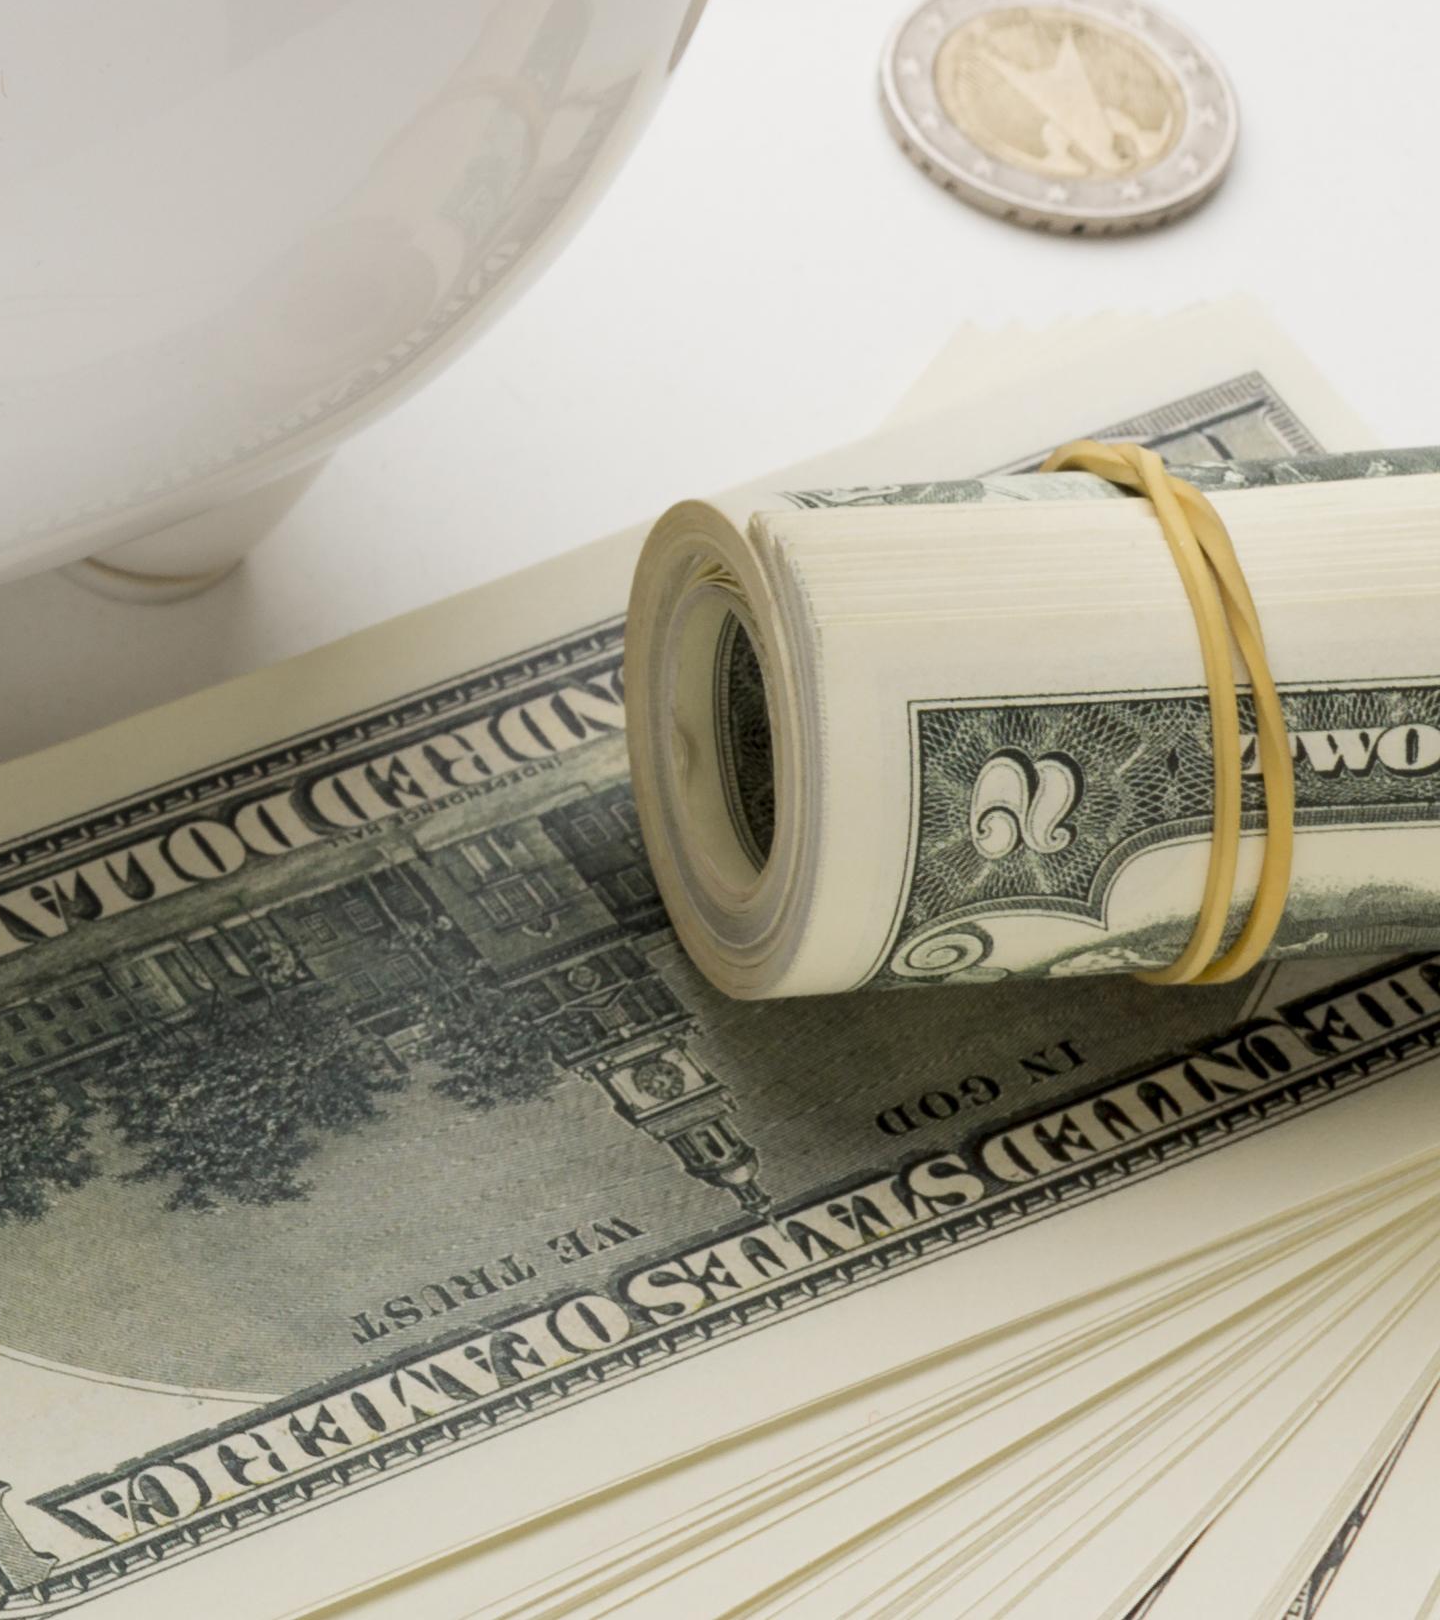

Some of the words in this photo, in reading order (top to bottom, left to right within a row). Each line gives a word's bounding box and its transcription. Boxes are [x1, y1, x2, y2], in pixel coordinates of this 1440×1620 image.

[398, 755, 563, 826] INDEPENDENCE
[969, 747, 1084, 859] 2
[325, 820, 383, 848] HALL
[1019, 1038, 1088, 1080] IN
[873, 1075, 1001, 1137] GOD
[982, 1021, 1302, 1182] UNITED
[547, 1214, 647, 1265] WE
[623, 1153, 985, 1323] STATES
[351, 1251, 537, 1346] TRUST
[52, 1332, 498, 1543] AMERICA
